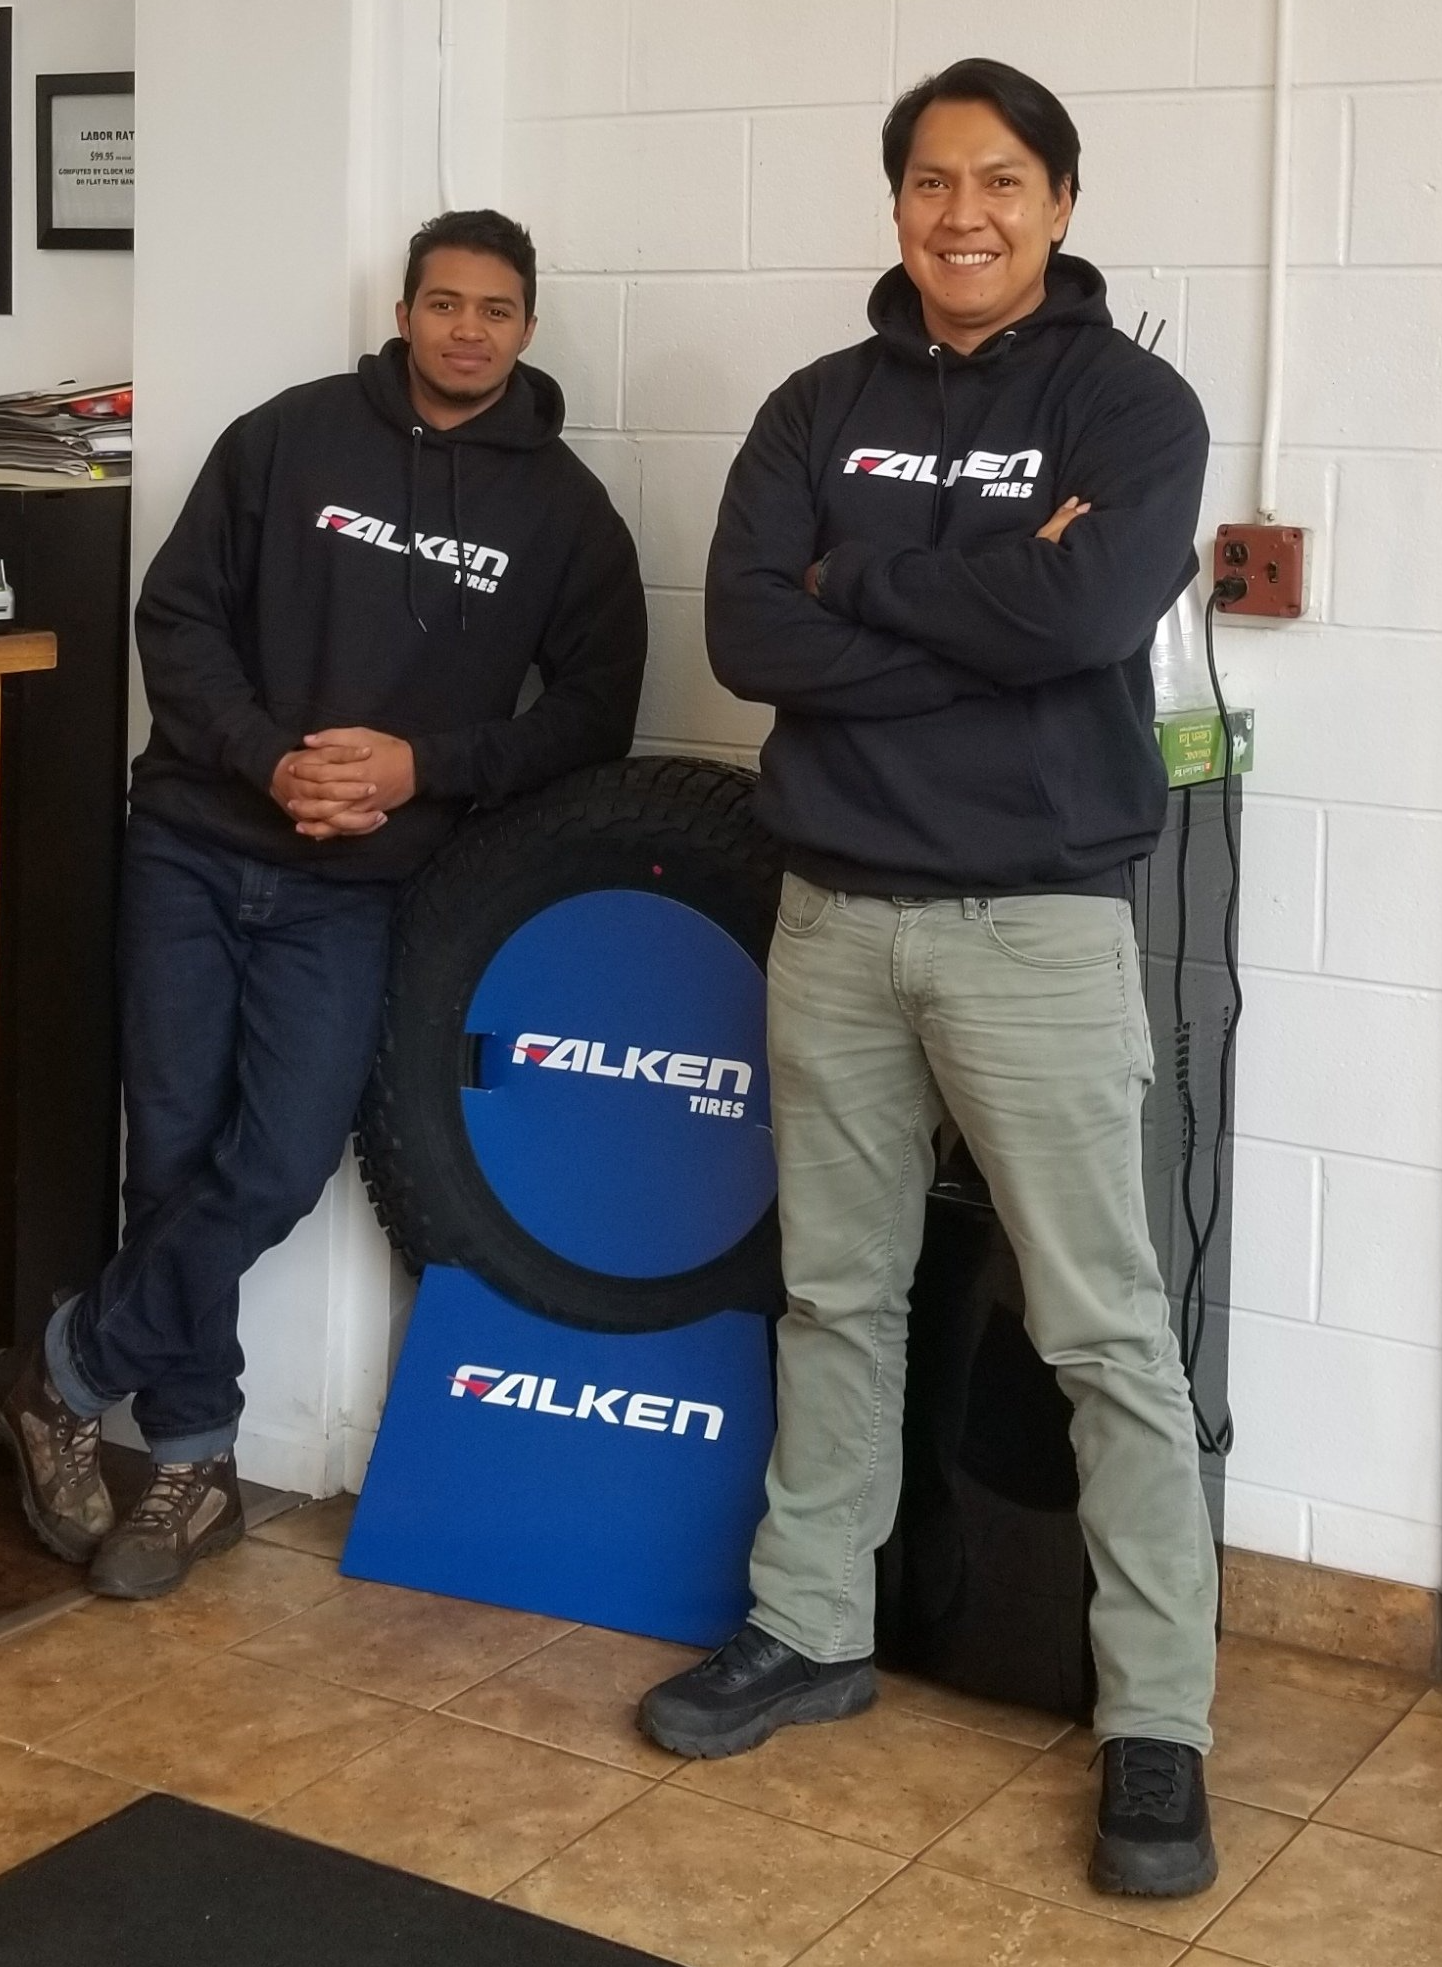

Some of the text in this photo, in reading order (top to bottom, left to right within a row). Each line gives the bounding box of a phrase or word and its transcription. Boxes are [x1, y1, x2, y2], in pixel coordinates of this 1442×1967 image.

[80, 131, 113, 141] LABOR
[90, 151, 114, 161] $99.95
[58, 168, 92, 176] COMPUTED
[93, 168, 101, 176] BY
[102, 168, 124, 176] CLOCK
[980, 482, 1034, 499] TIRES
[315, 505, 509, 578] FALKEN
[453, 570, 499, 594] TRES
[1178, 729, 1212, 748] Green Tea
[1184, 748, 1211, 761] ORGANIC
[509, 1033, 753, 1095] FALKEN
[689, 1095, 745, 1119] TIRES
[448, 1364, 724, 1441] FALKEN
